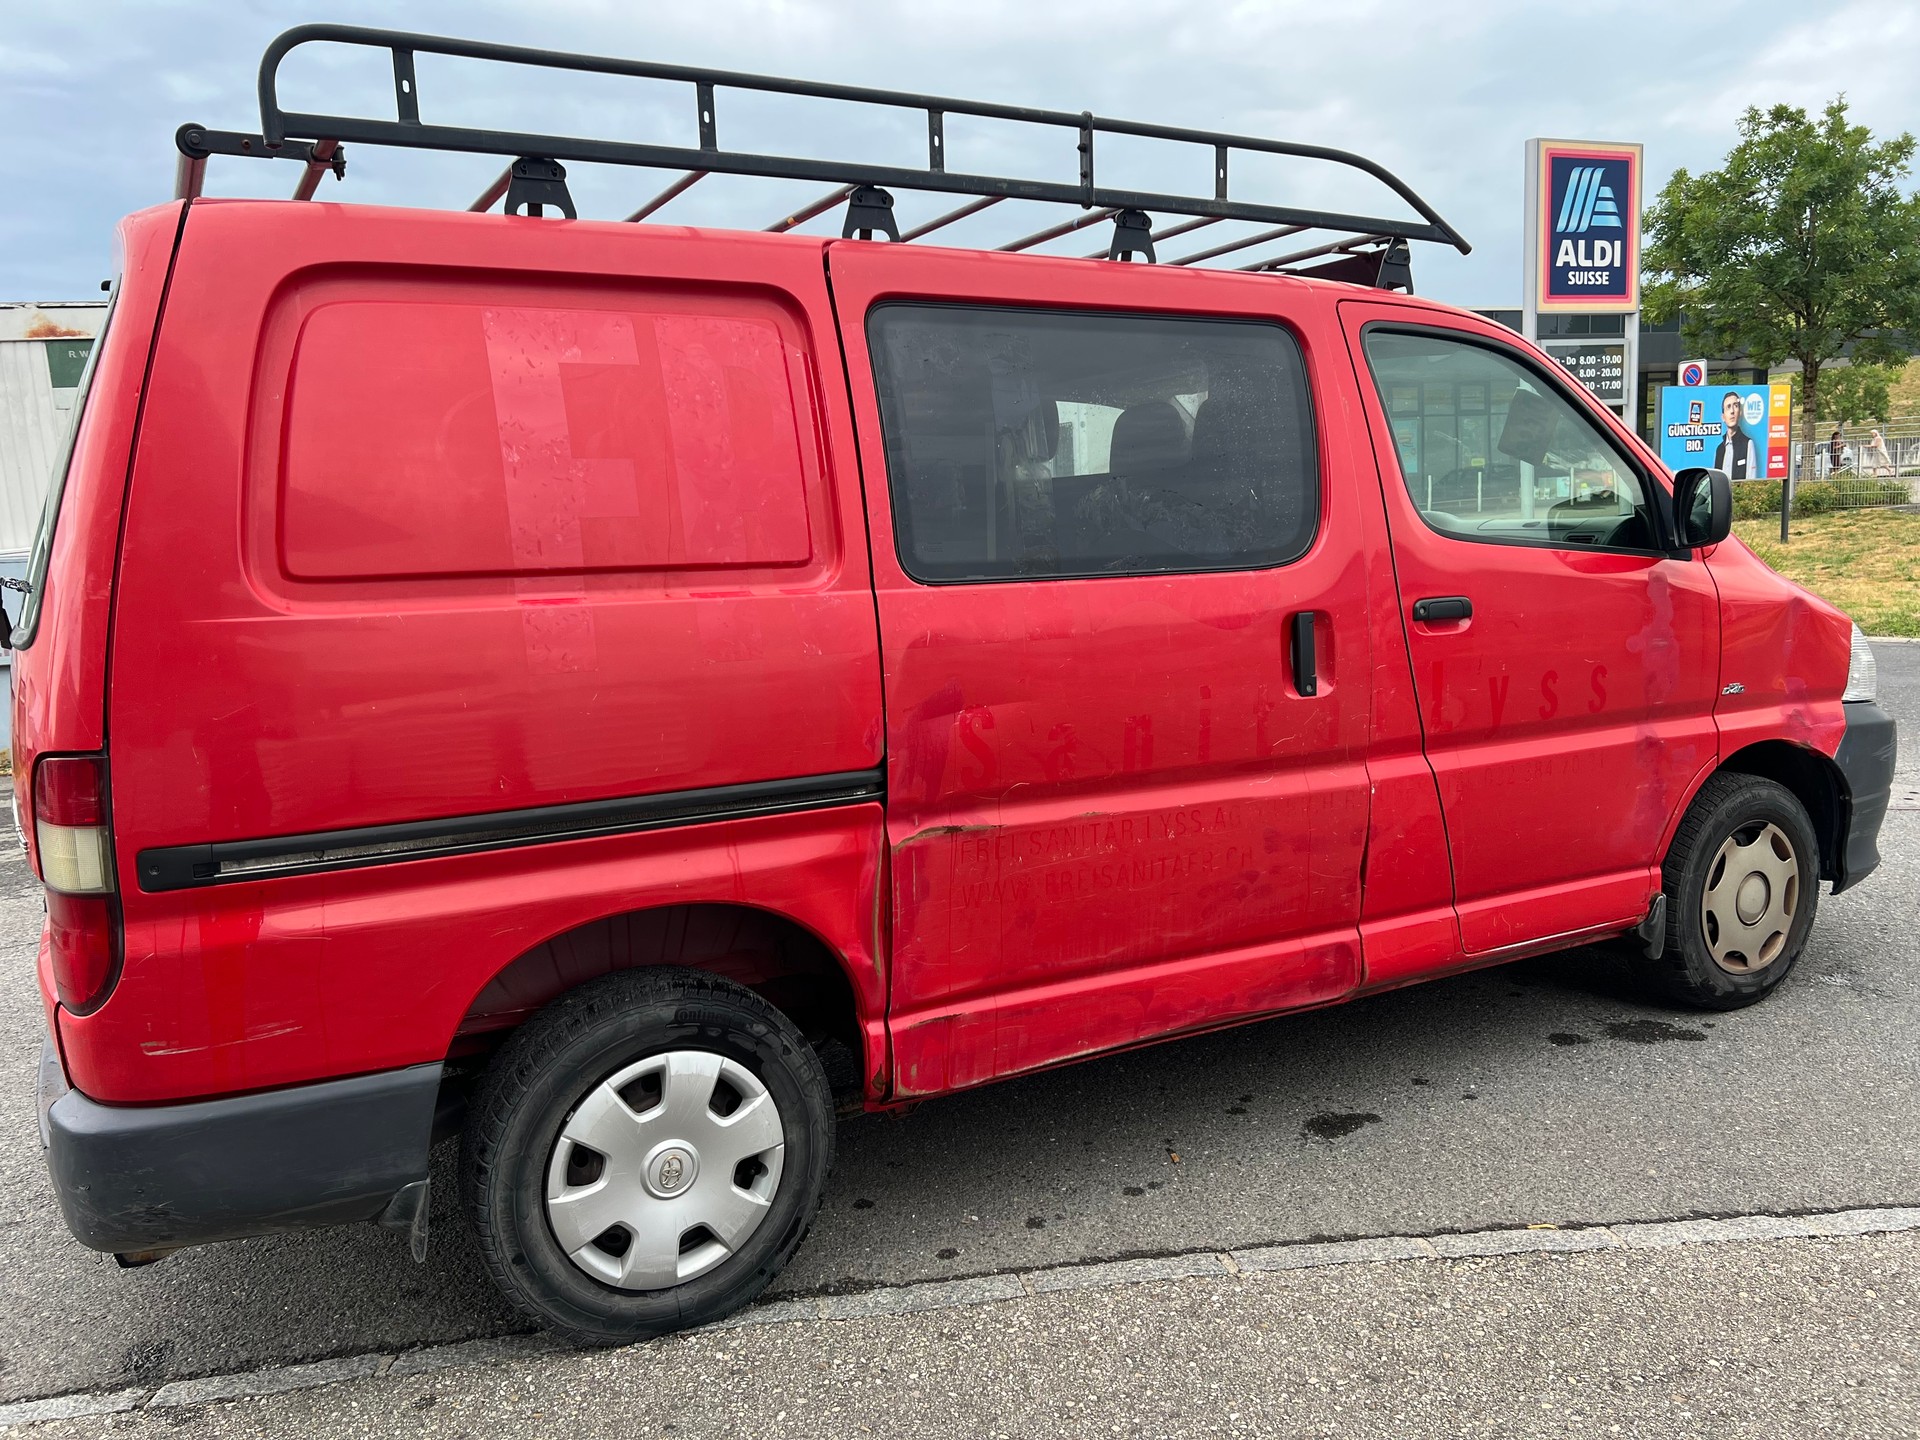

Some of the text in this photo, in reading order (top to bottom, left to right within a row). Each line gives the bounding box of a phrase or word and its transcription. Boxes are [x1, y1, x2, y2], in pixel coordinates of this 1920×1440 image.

[1556, 239, 1621, 268] ALDI
[1568, 271, 1610, 285] SUISSE
[1566, 356, 1577, 366] Do
[1579, 355, 1597, 365] 8.00
[1601, 354, 1622, 364] 19.00
[1579, 368, 1596, 378] 8.00
[1601, 367, 1622, 377] 20.00
[1601, 380, 1622, 390] 17.00
[1747, 400, 1762, 411] WIE
[1668, 422, 1721, 437] GÜNSTIGSTES
[1686, 441, 1703, 452] BIO.
